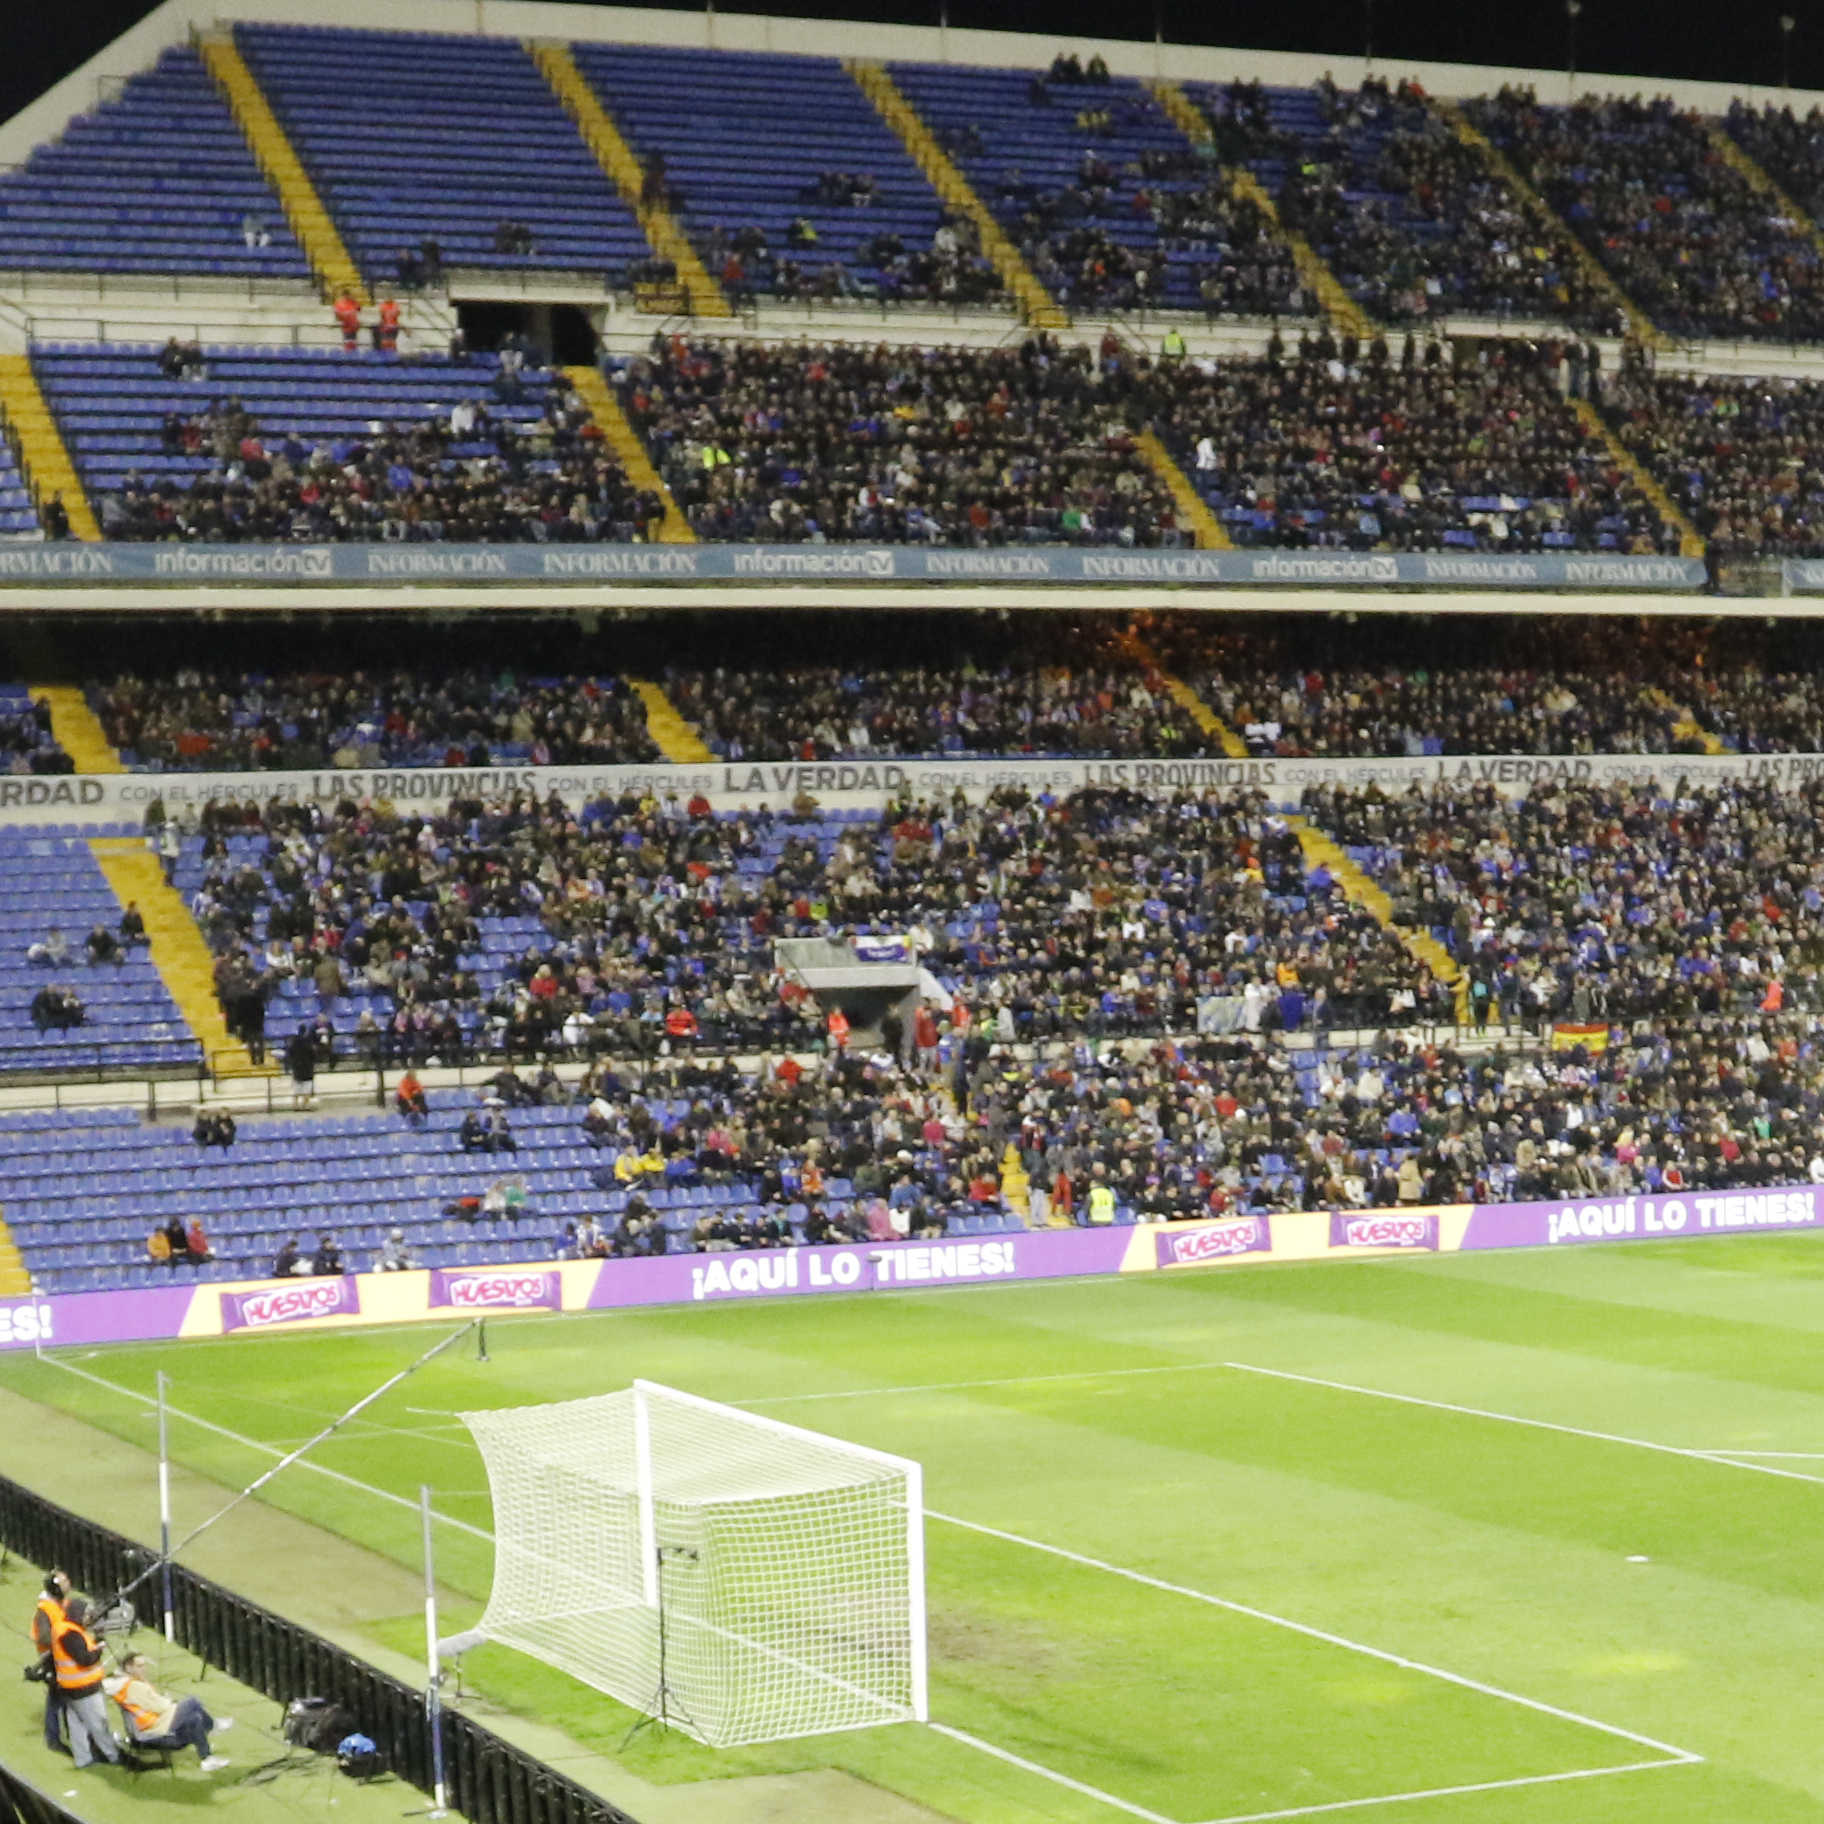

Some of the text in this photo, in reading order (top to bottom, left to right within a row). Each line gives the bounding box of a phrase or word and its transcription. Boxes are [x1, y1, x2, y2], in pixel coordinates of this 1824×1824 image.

[368, 549, 507, 574] INFORMACIÓN
[544, 549, 698, 575] INFORMACIÓN
[926, 552, 1050, 575] INFORMACIÓN
[1082, 553, 1220, 578] INFORMACIÓN
[121, 786, 163, 801] CON
[169, 786, 191, 800] EL
[313, 774, 364, 800] LAS
[371, 771, 537, 800] PROVINCIAS
[724, 766, 762, 793] LA
[772, 765, 905, 792] VERDAD
[1084, 764, 1128, 786] LAS
[1135, 762, 1276, 786] PROVINCIAS
[1438, 761, 1471, 782] LA
[1480, 759, 1592, 783] VERDAD
[1548, 1192, 1816, 1243] ¡AQUÍ LO TIENES!
[692, 1242, 1016, 1300] ¡AQUÍ LO TIENES!
